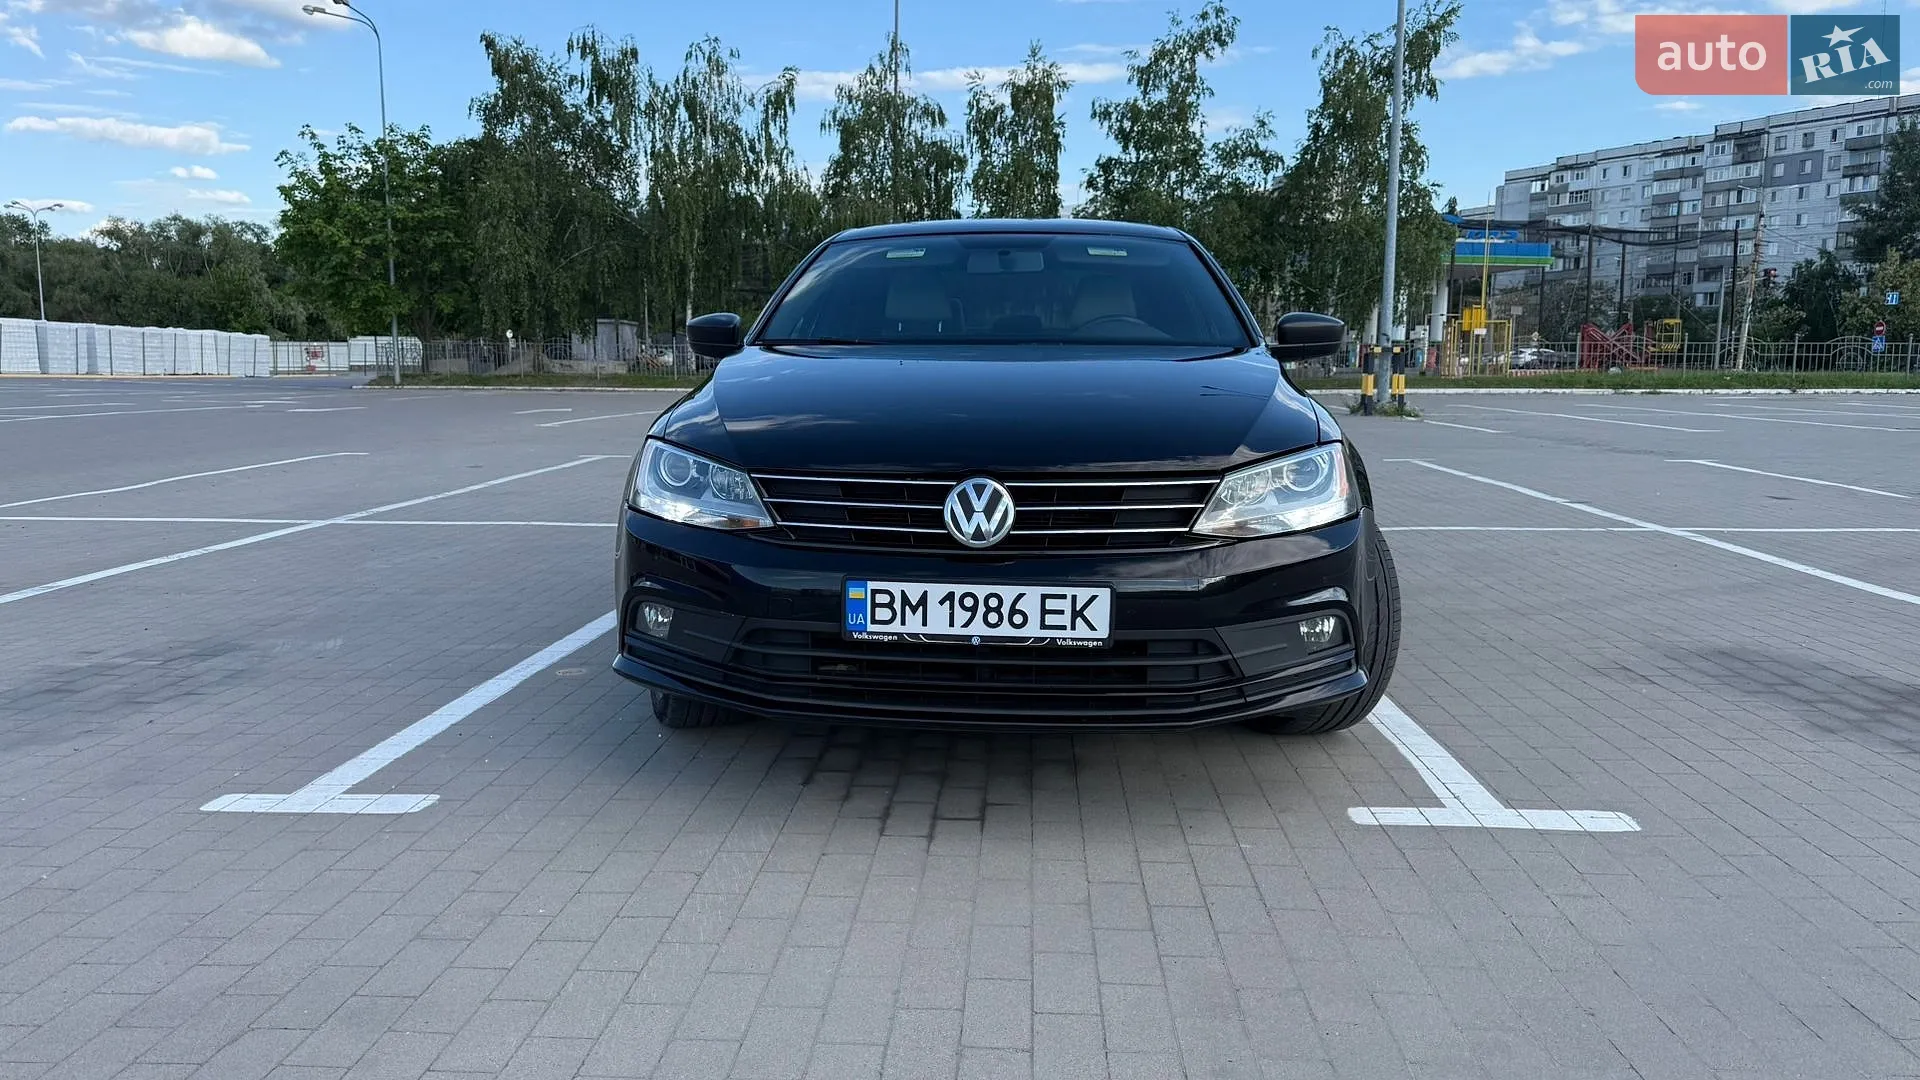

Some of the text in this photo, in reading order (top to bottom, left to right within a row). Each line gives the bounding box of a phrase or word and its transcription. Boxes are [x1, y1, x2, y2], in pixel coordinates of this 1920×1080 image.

[869, 588, 1099, 632] BM 1986 EK
[848, 613, 865, 625] UA
[852, 631, 898, 641] Volkswagen
[1056, 638, 1103, 647] Volkswagen
